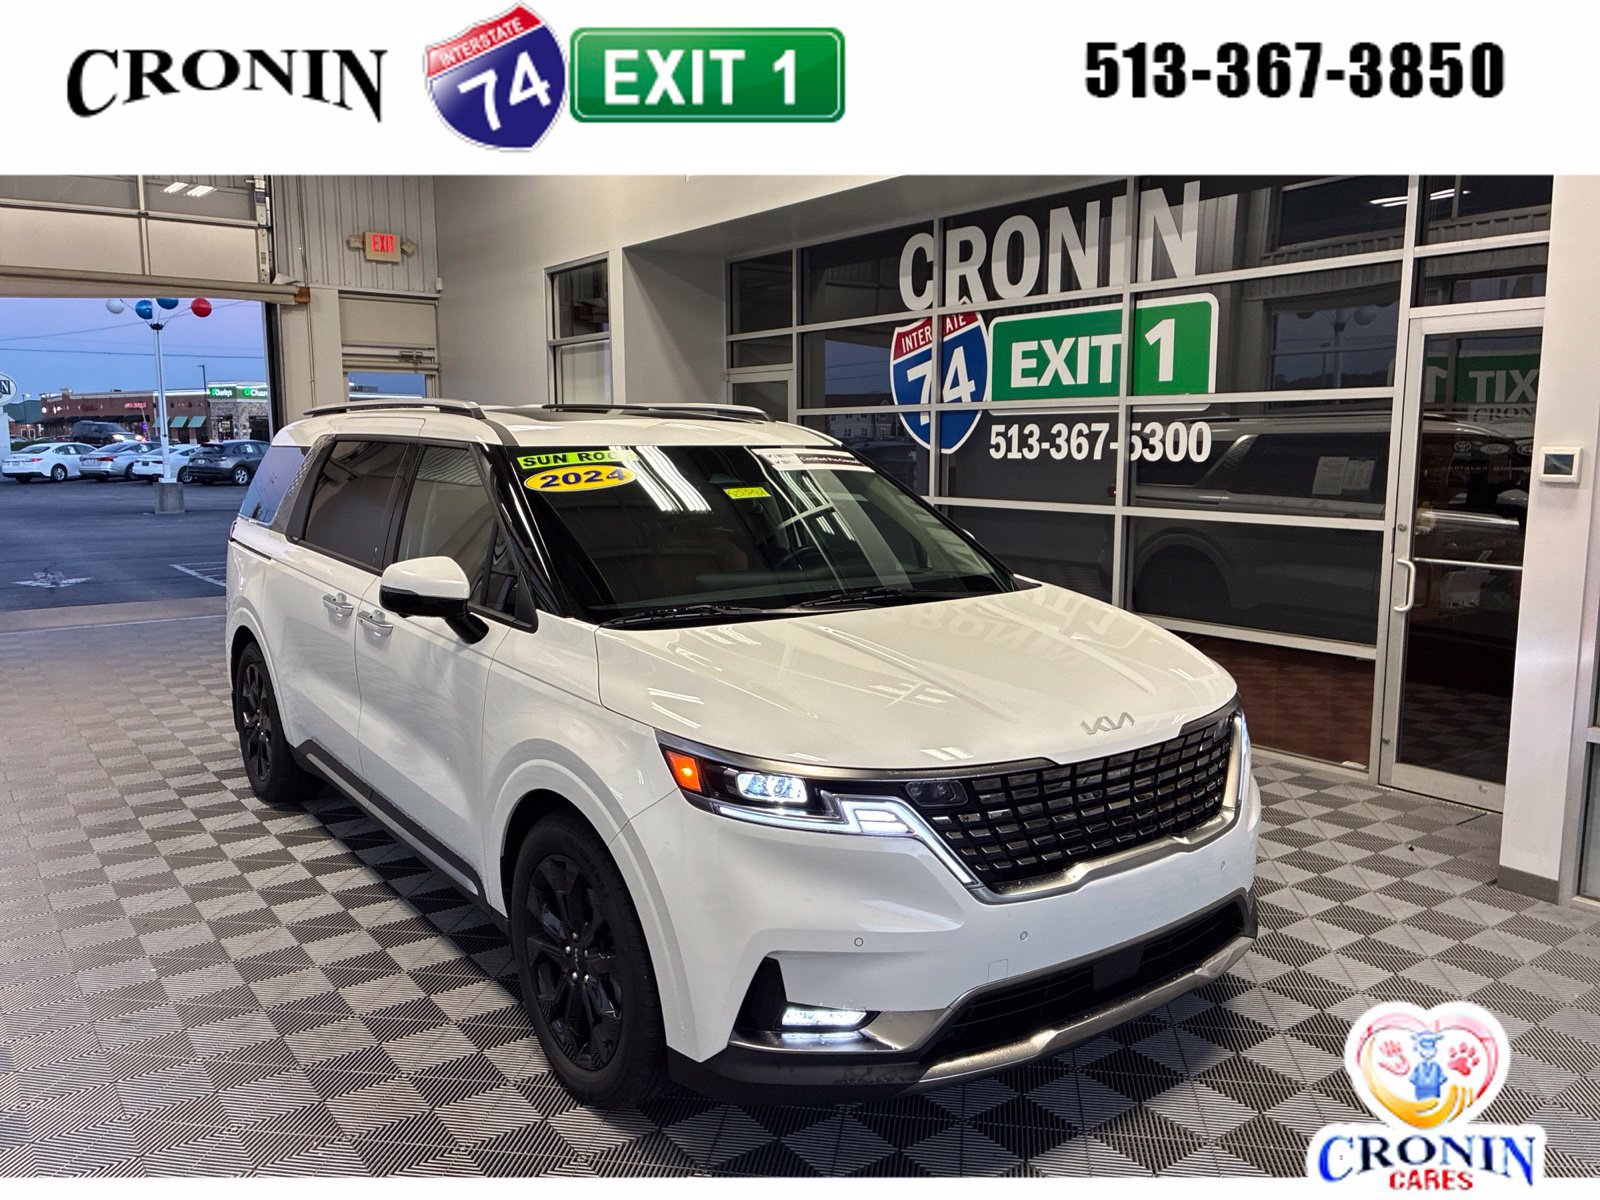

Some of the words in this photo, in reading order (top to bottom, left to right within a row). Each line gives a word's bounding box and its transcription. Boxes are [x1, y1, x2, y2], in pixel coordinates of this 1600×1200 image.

[371, 233, 396, 254] EXIT
[899, 180, 1200, 311] CRONIN
[902, 313, 967, 354] INTERATE
[1010, 333, 1122, 388] EXIT
[1144, 318, 1176, 383] 1
[906, 345, 976, 426] 74
[523, 454, 568, 467] SUN
[577, 451, 622, 463] ROO
[989, 421, 1212, 463] 513-367-5300
[540, 469, 625, 489] 2024
